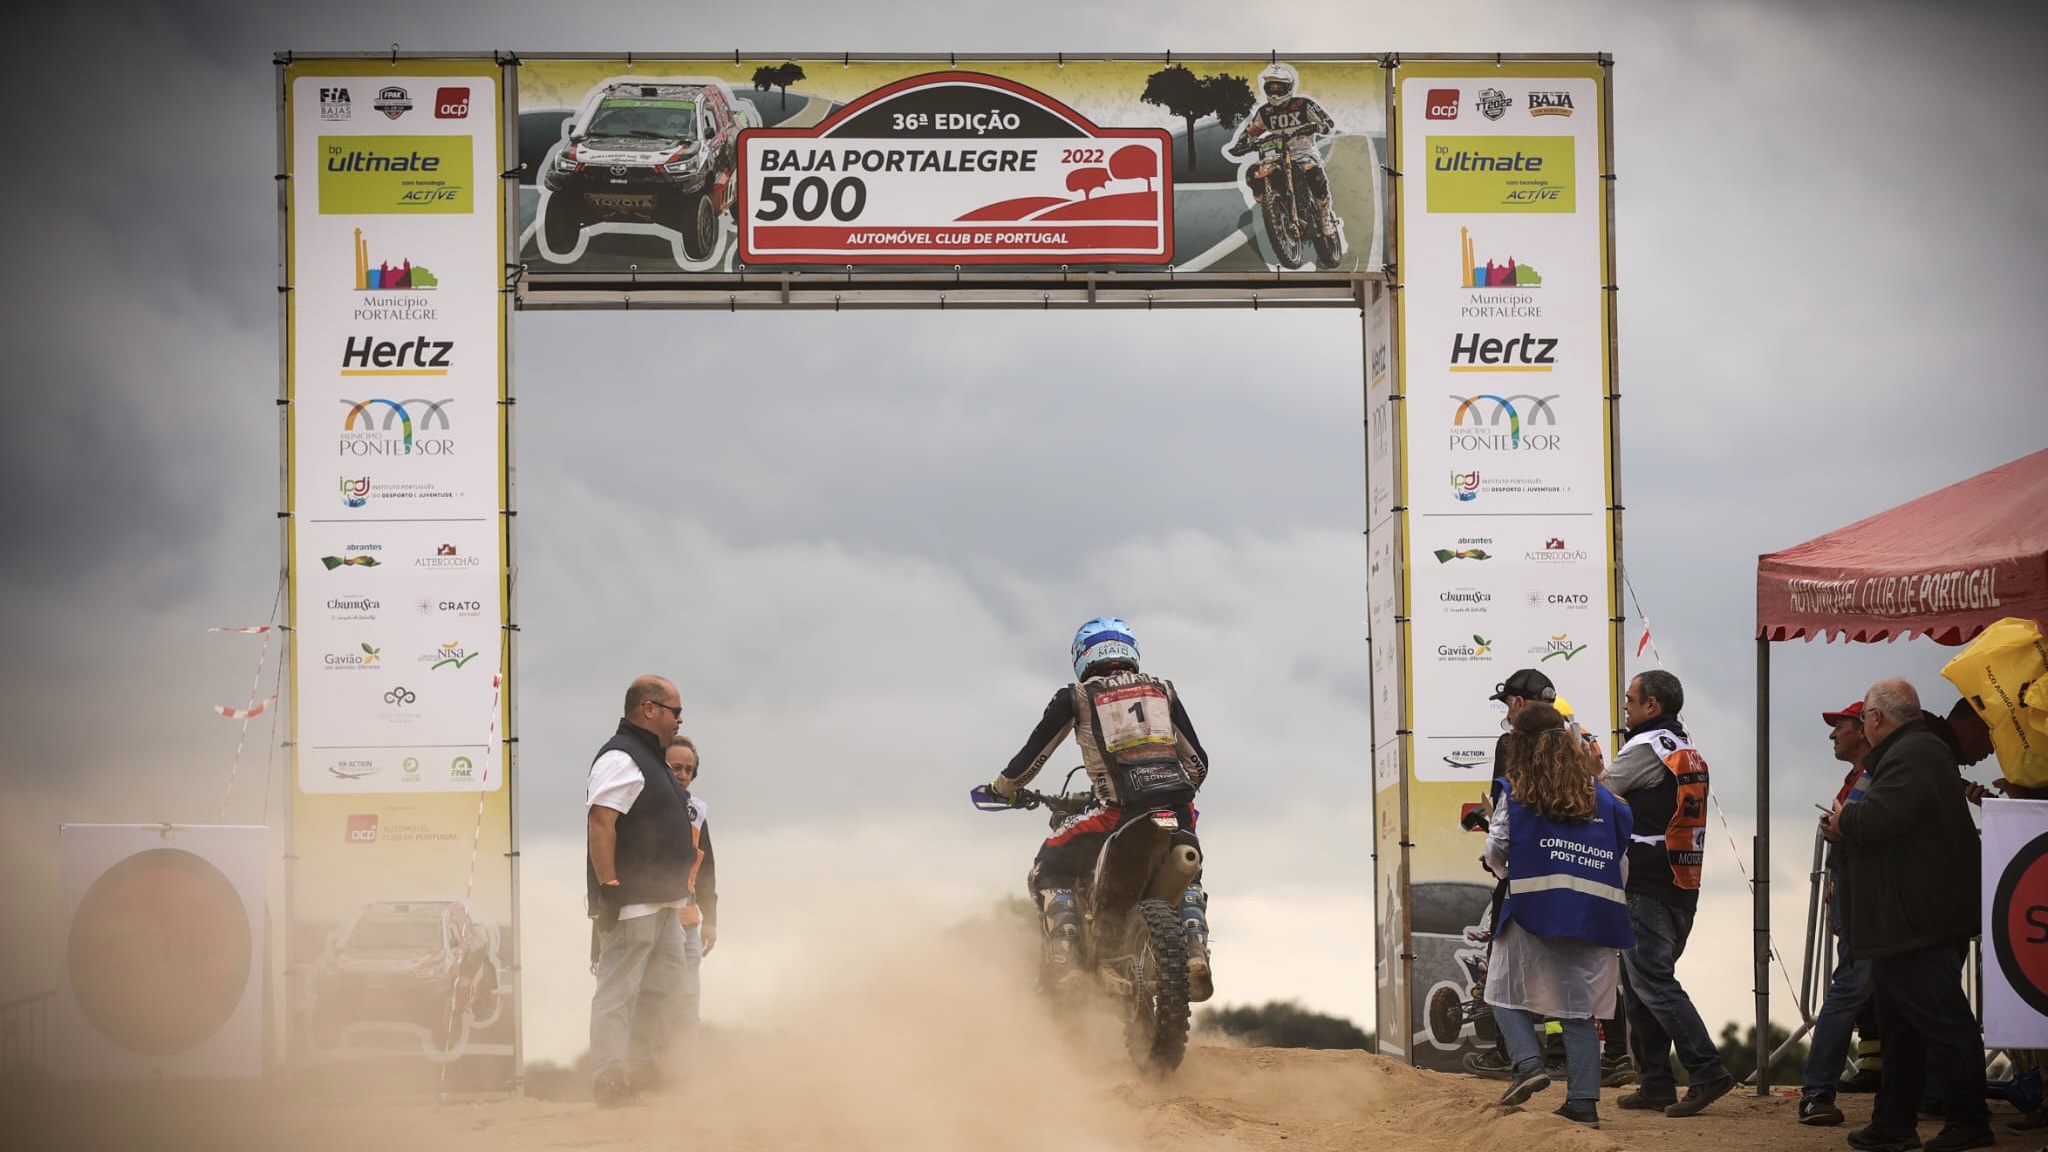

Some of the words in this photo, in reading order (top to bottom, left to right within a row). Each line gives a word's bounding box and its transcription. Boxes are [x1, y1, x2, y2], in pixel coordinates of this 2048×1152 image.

[1528, 94, 1574, 109] BAJA
[321, 106, 351, 115] BAJAS
[441, 103, 468, 117] acp
[1431, 106, 1457, 118] acp
[892, 113, 928, 130] 36ª
[935, 110, 1020, 135] EDIÇÃO
[1269, 112, 1302, 128] FOX
[329, 145, 342, 156] bp
[1061, 149, 1104, 163] 2022
[1436, 145, 1448, 155] bp
[328, 151, 440, 172] ultimate
[760, 150, 836, 172] BAJA
[842, 150, 1038, 172] PORTALEGRE
[1435, 151, 1543, 172] ultimate
[402, 190, 458, 200] ACTIVE
[754, 176, 866, 222] 500
[1506, 190, 1560, 200] ACTIVE
[592, 198, 652, 208] TOYOTA
[846, 230, 932, 244] AUTOMÓVEL
[935, 233, 971, 244] CLUB
[974, 233, 992, 244] DE
[996, 233, 1068, 244] PORTUGAL
[364, 296, 428, 310] Município
[1470, 294, 1532, 307] Município
[354, 309, 438, 320] PORTALEGRE
[1462, 306, 1542, 317] PORTALEGRE
[342, 336, 454, 368] Hertz
[1450, 333, 1558, 364] Hertz
[340, 440, 401, 456] PONTE
[416, 440, 454, 455] SOR
[1450, 435, 1510, 451] PONTE
[1523, 435, 1560, 450] SOR
[340, 476, 370, 497] ipdj
[1450, 470, 1479, 490] ipdj
[346, 543, 382, 551] abrantes
[1788, 573, 1859, 614] AUTOMÓVEL
[1862, 577, 1897, 614] CLUB
[1899, 576, 1918, 613] DE
[1920, 568, 2000, 612] PORTUGAL
[439, 601, 480, 611] CRATO
[1547, 594, 1588, 604] CRATO
[1438, 645, 1474, 656] Gavião
[325, 653, 362, 665] Gavião
[1985, 664, 1997, 684] SACO
[1994, 685, 2013, 708] AMIGO
[1128, 702, 1145, 723] 1
[451, 769, 472, 778] FPAK
[352, 830, 376, 841] acp
[1539, 838, 1614, 860] CONTROLADOR
[1550, 850, 1576, 864] POST
[1578, 854, 1606, 870] CHIEF
